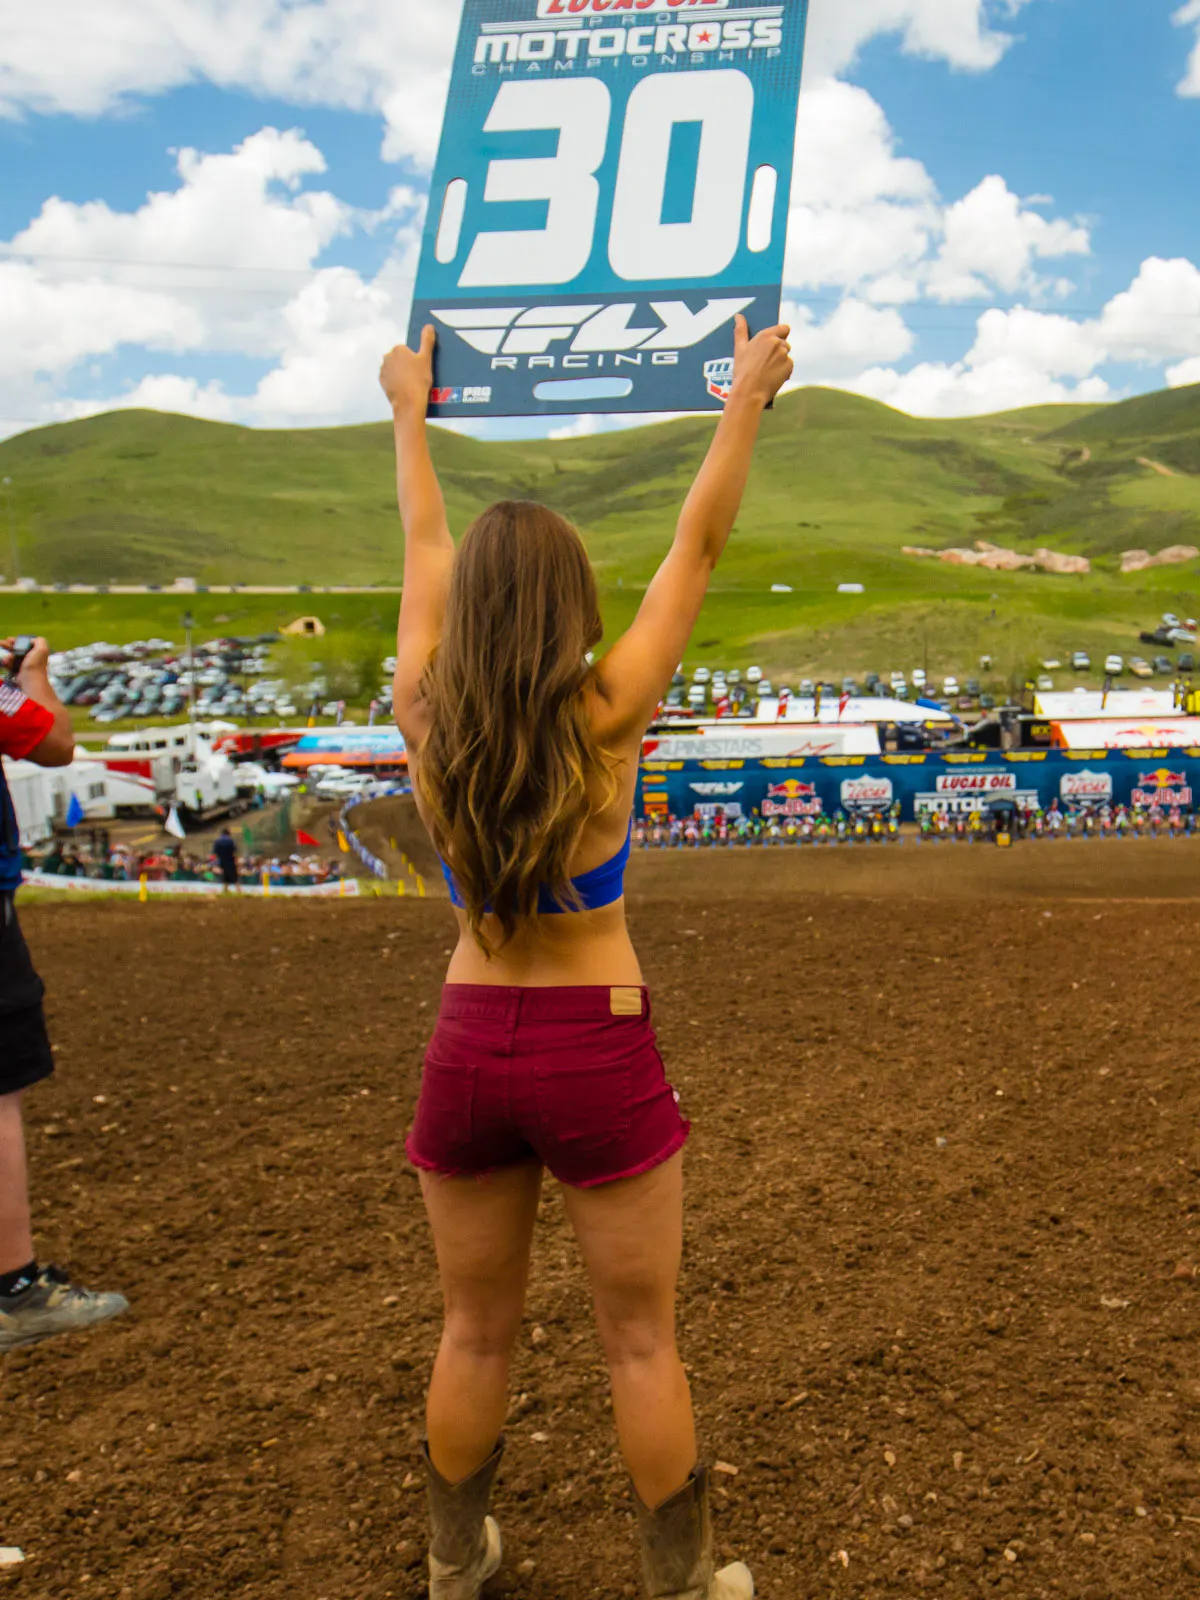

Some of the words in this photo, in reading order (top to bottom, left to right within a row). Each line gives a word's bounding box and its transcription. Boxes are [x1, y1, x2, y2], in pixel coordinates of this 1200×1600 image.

[589, 12, 672, 28] PRO
[473, 18, 784, 63] MOTOCROSS
[471, 46, 782, 76] CHAMPIONSHIP
[457, 69, 755, 288] 30
[430, 297, 757, 354] FLY
[490, 351, 680, 371] RACING
[941, 776, 987, 789] LUCAS
[990, 775, 1012, 788] OIL
